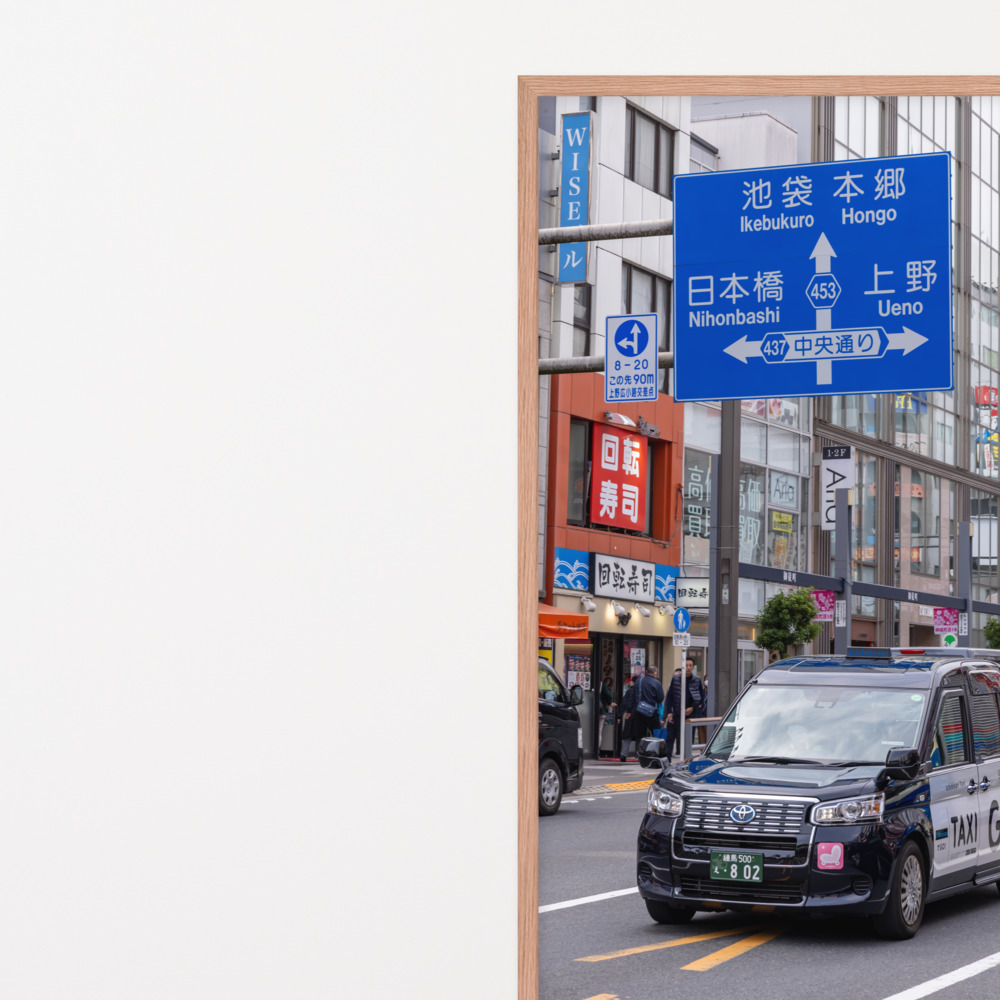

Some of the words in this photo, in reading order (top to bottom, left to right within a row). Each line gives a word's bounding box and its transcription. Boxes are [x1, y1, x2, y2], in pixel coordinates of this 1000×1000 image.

[742, 175, 813, 211] 池袋
[833, 167, 906, 203] 本郷
[740, 213, 814, 232] Ikebukuro
[841, 207, 897, 226] Hongo
[688, 270, 784, 307] 日本橋
[810, 282, 836, 299] 453
[863, 259, 938, 295] 上野
[689, 306, 780, 327] Nihonbashi
[878, 299, 923, 317] Ueno
[763, 339, 787, 356] 437
[794, 333, 874, 357] 中央通り
[601, 433, 640, 478] 回転
[599, 479, 639, 524] 寿司
[598, 562, 653, 597] 回転寿司
[950, 811, 978, 849] TAXI
